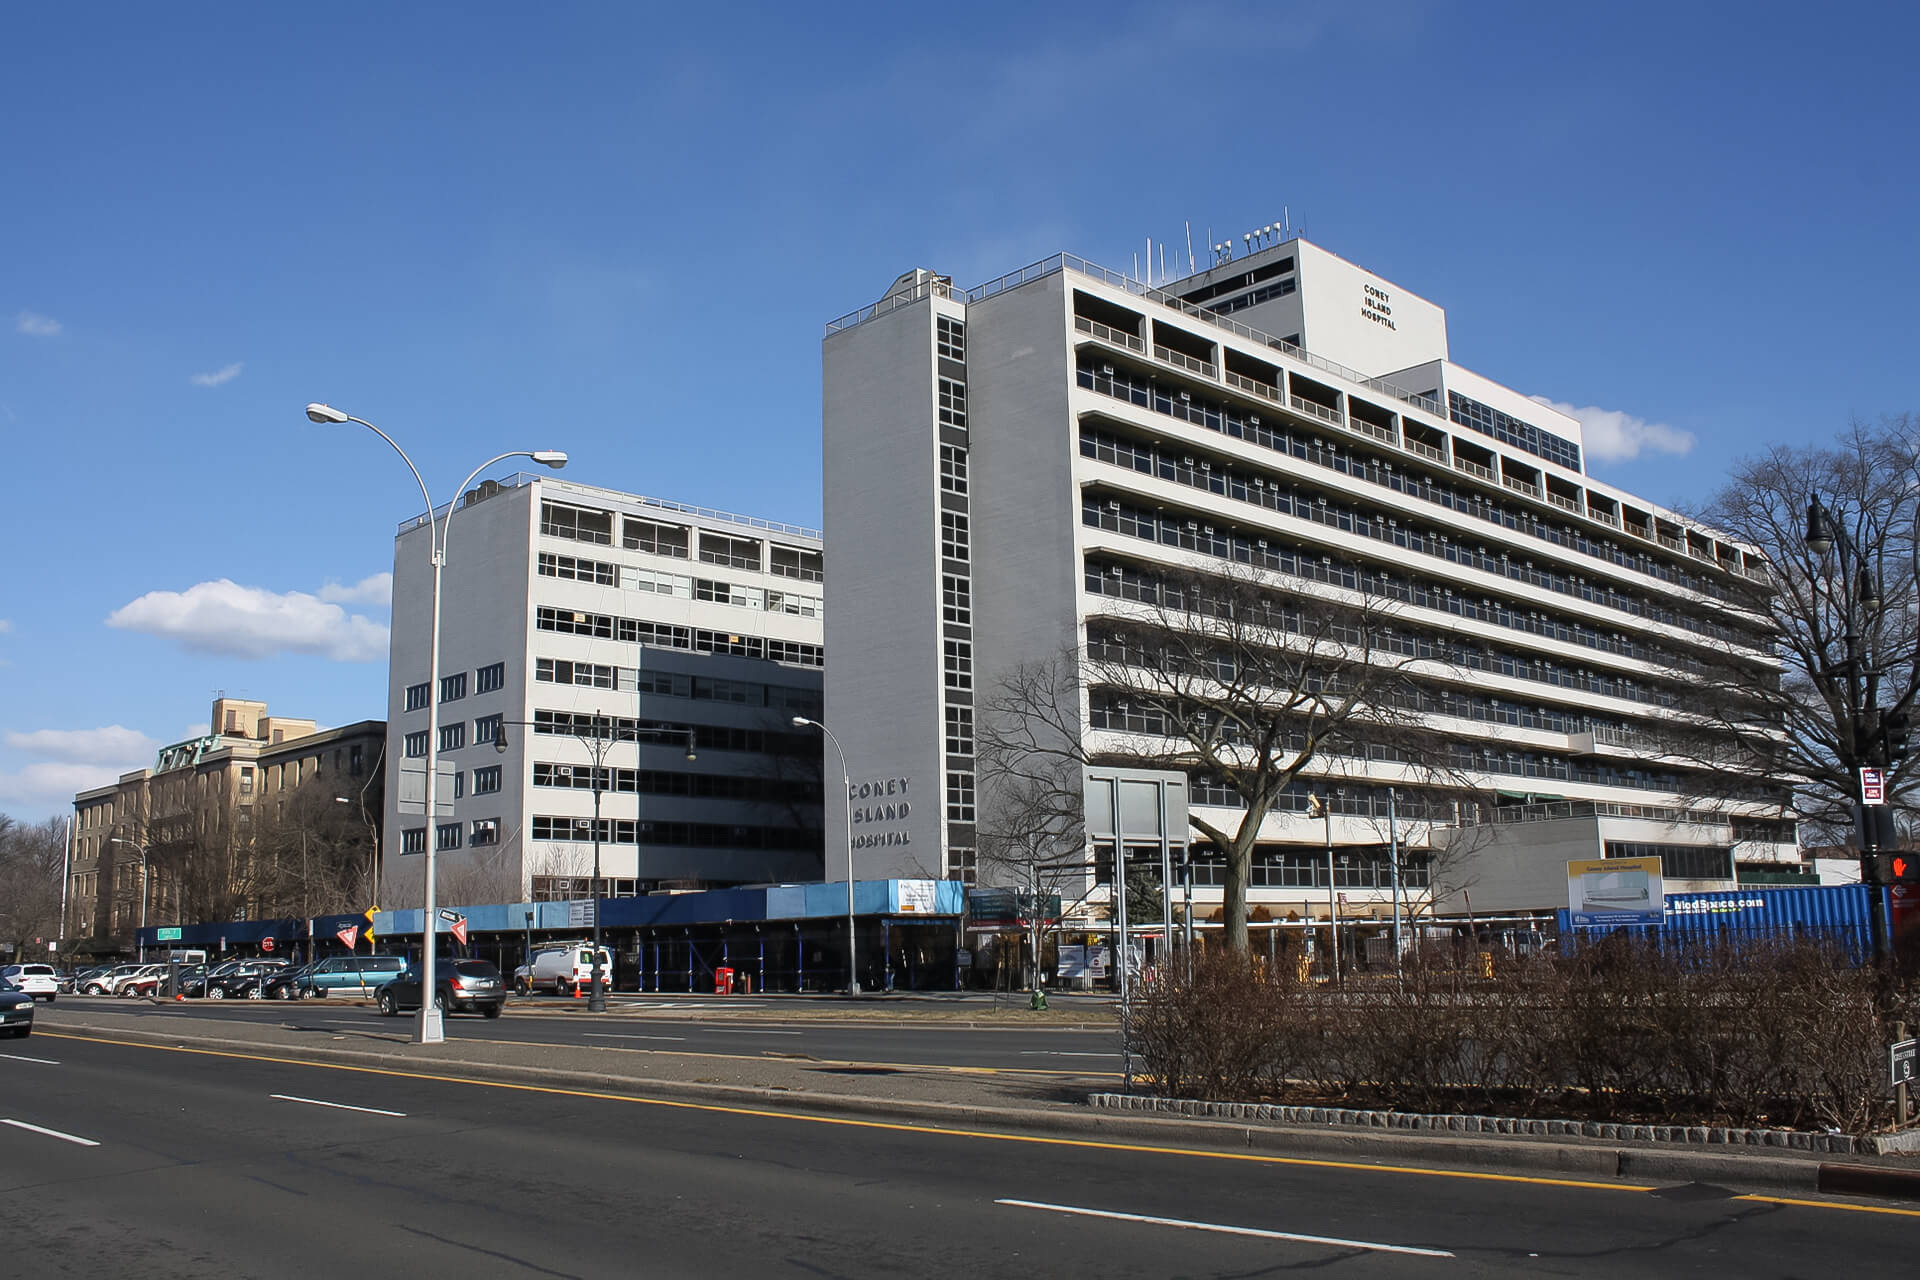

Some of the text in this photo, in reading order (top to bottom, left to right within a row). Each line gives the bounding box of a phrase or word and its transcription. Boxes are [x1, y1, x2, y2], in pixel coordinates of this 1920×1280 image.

[1364, 284, 1390, 303] CONEY
[1365, 297, 1391, 315] ISLAND
[1361, 308, 1396, 331] HOSPITAL
[849, 777, 911, 800] CONEY
[850, 802, 912, 823] ISLAND
